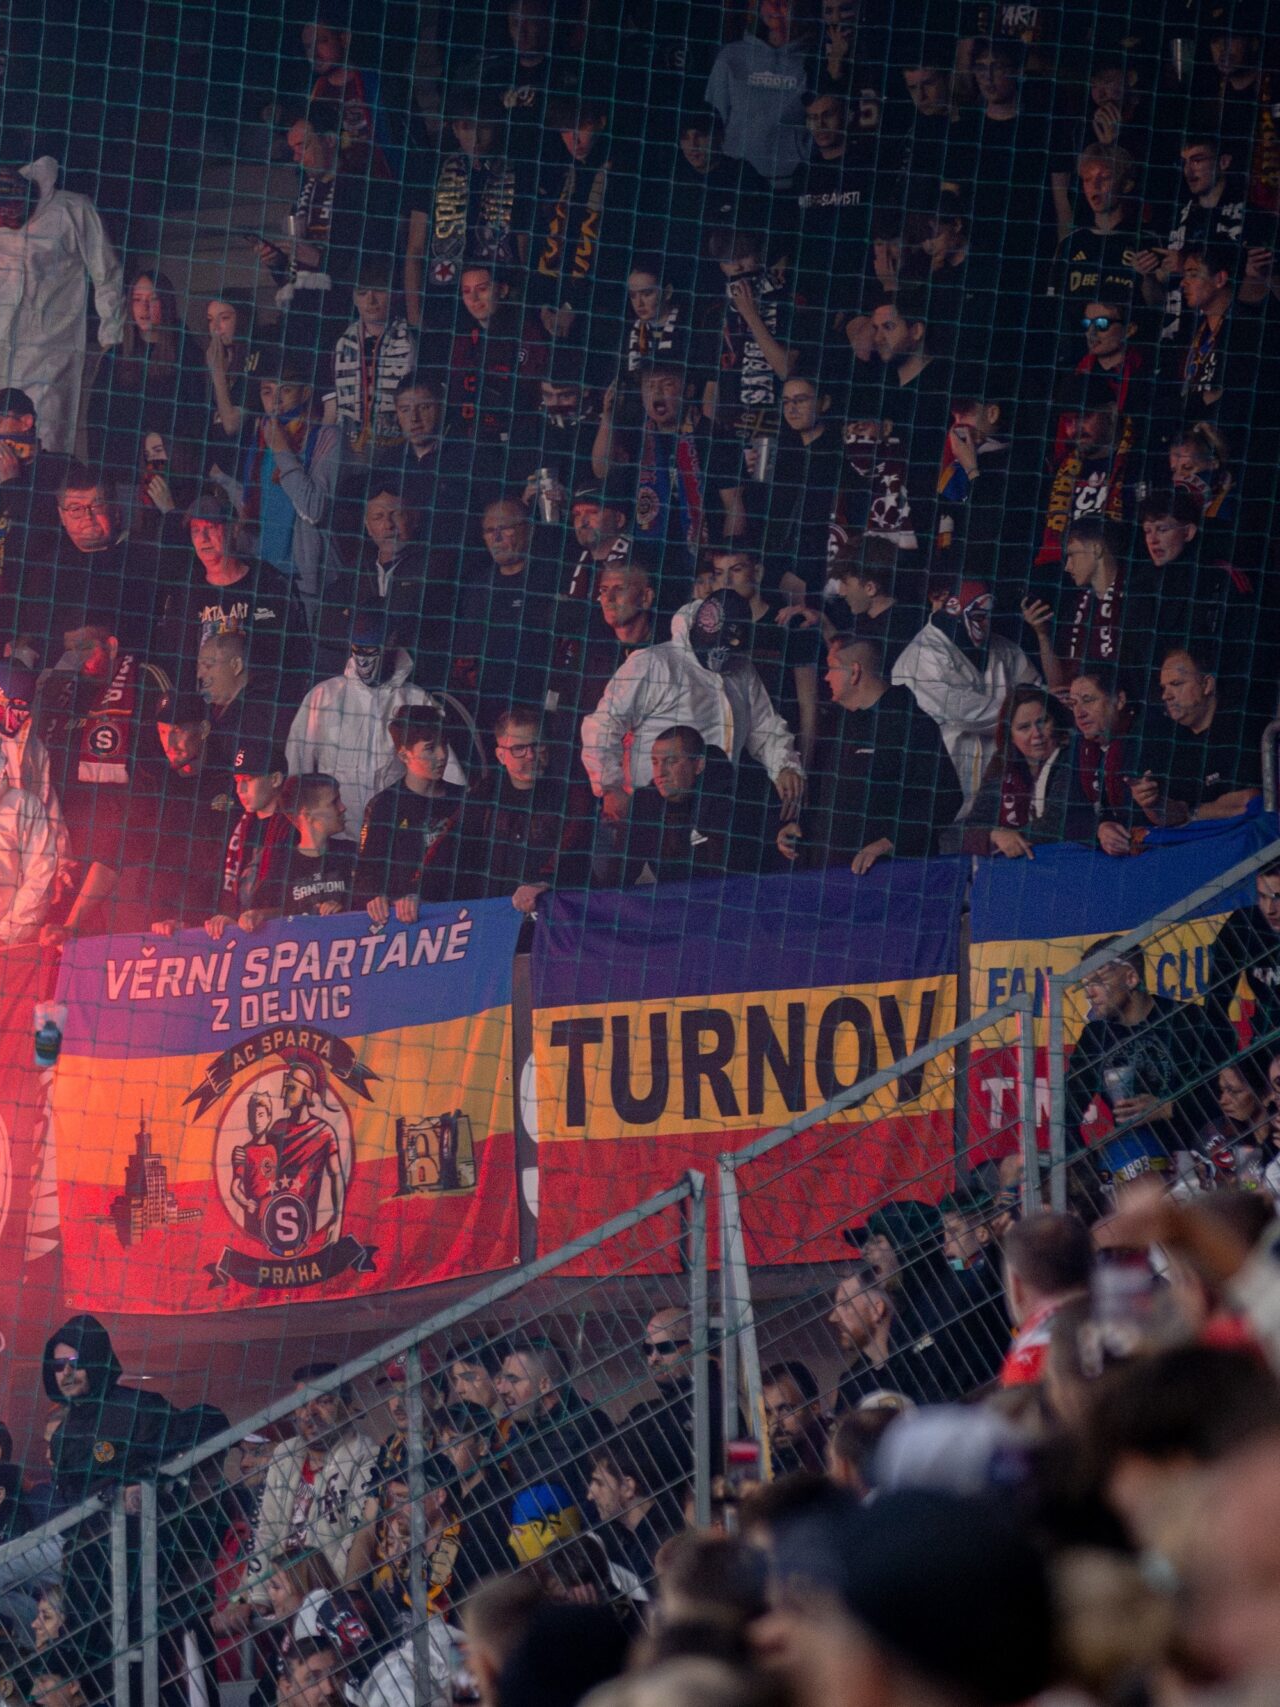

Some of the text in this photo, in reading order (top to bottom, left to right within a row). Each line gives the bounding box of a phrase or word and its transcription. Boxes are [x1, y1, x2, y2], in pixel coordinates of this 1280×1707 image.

[96, 731, 113, 749] S
[105, 909, 473, 1001] VĚRNÍ SPARŤANÉ
[987, 966, 1054, 1018] FAN
[1156, 943, 1213, 1000] CLU
[211, 985, 352, 1033] Z DEJVIC
[233, 1031, 332, 1071] AC SPARTA
[549, 989, 937, 1128] TURNOV
[1121, 1155, 1150, 1181] 1893
[275, 1206, 300, 1242] S
[259, 1261, 323, 1285] PRAHA
